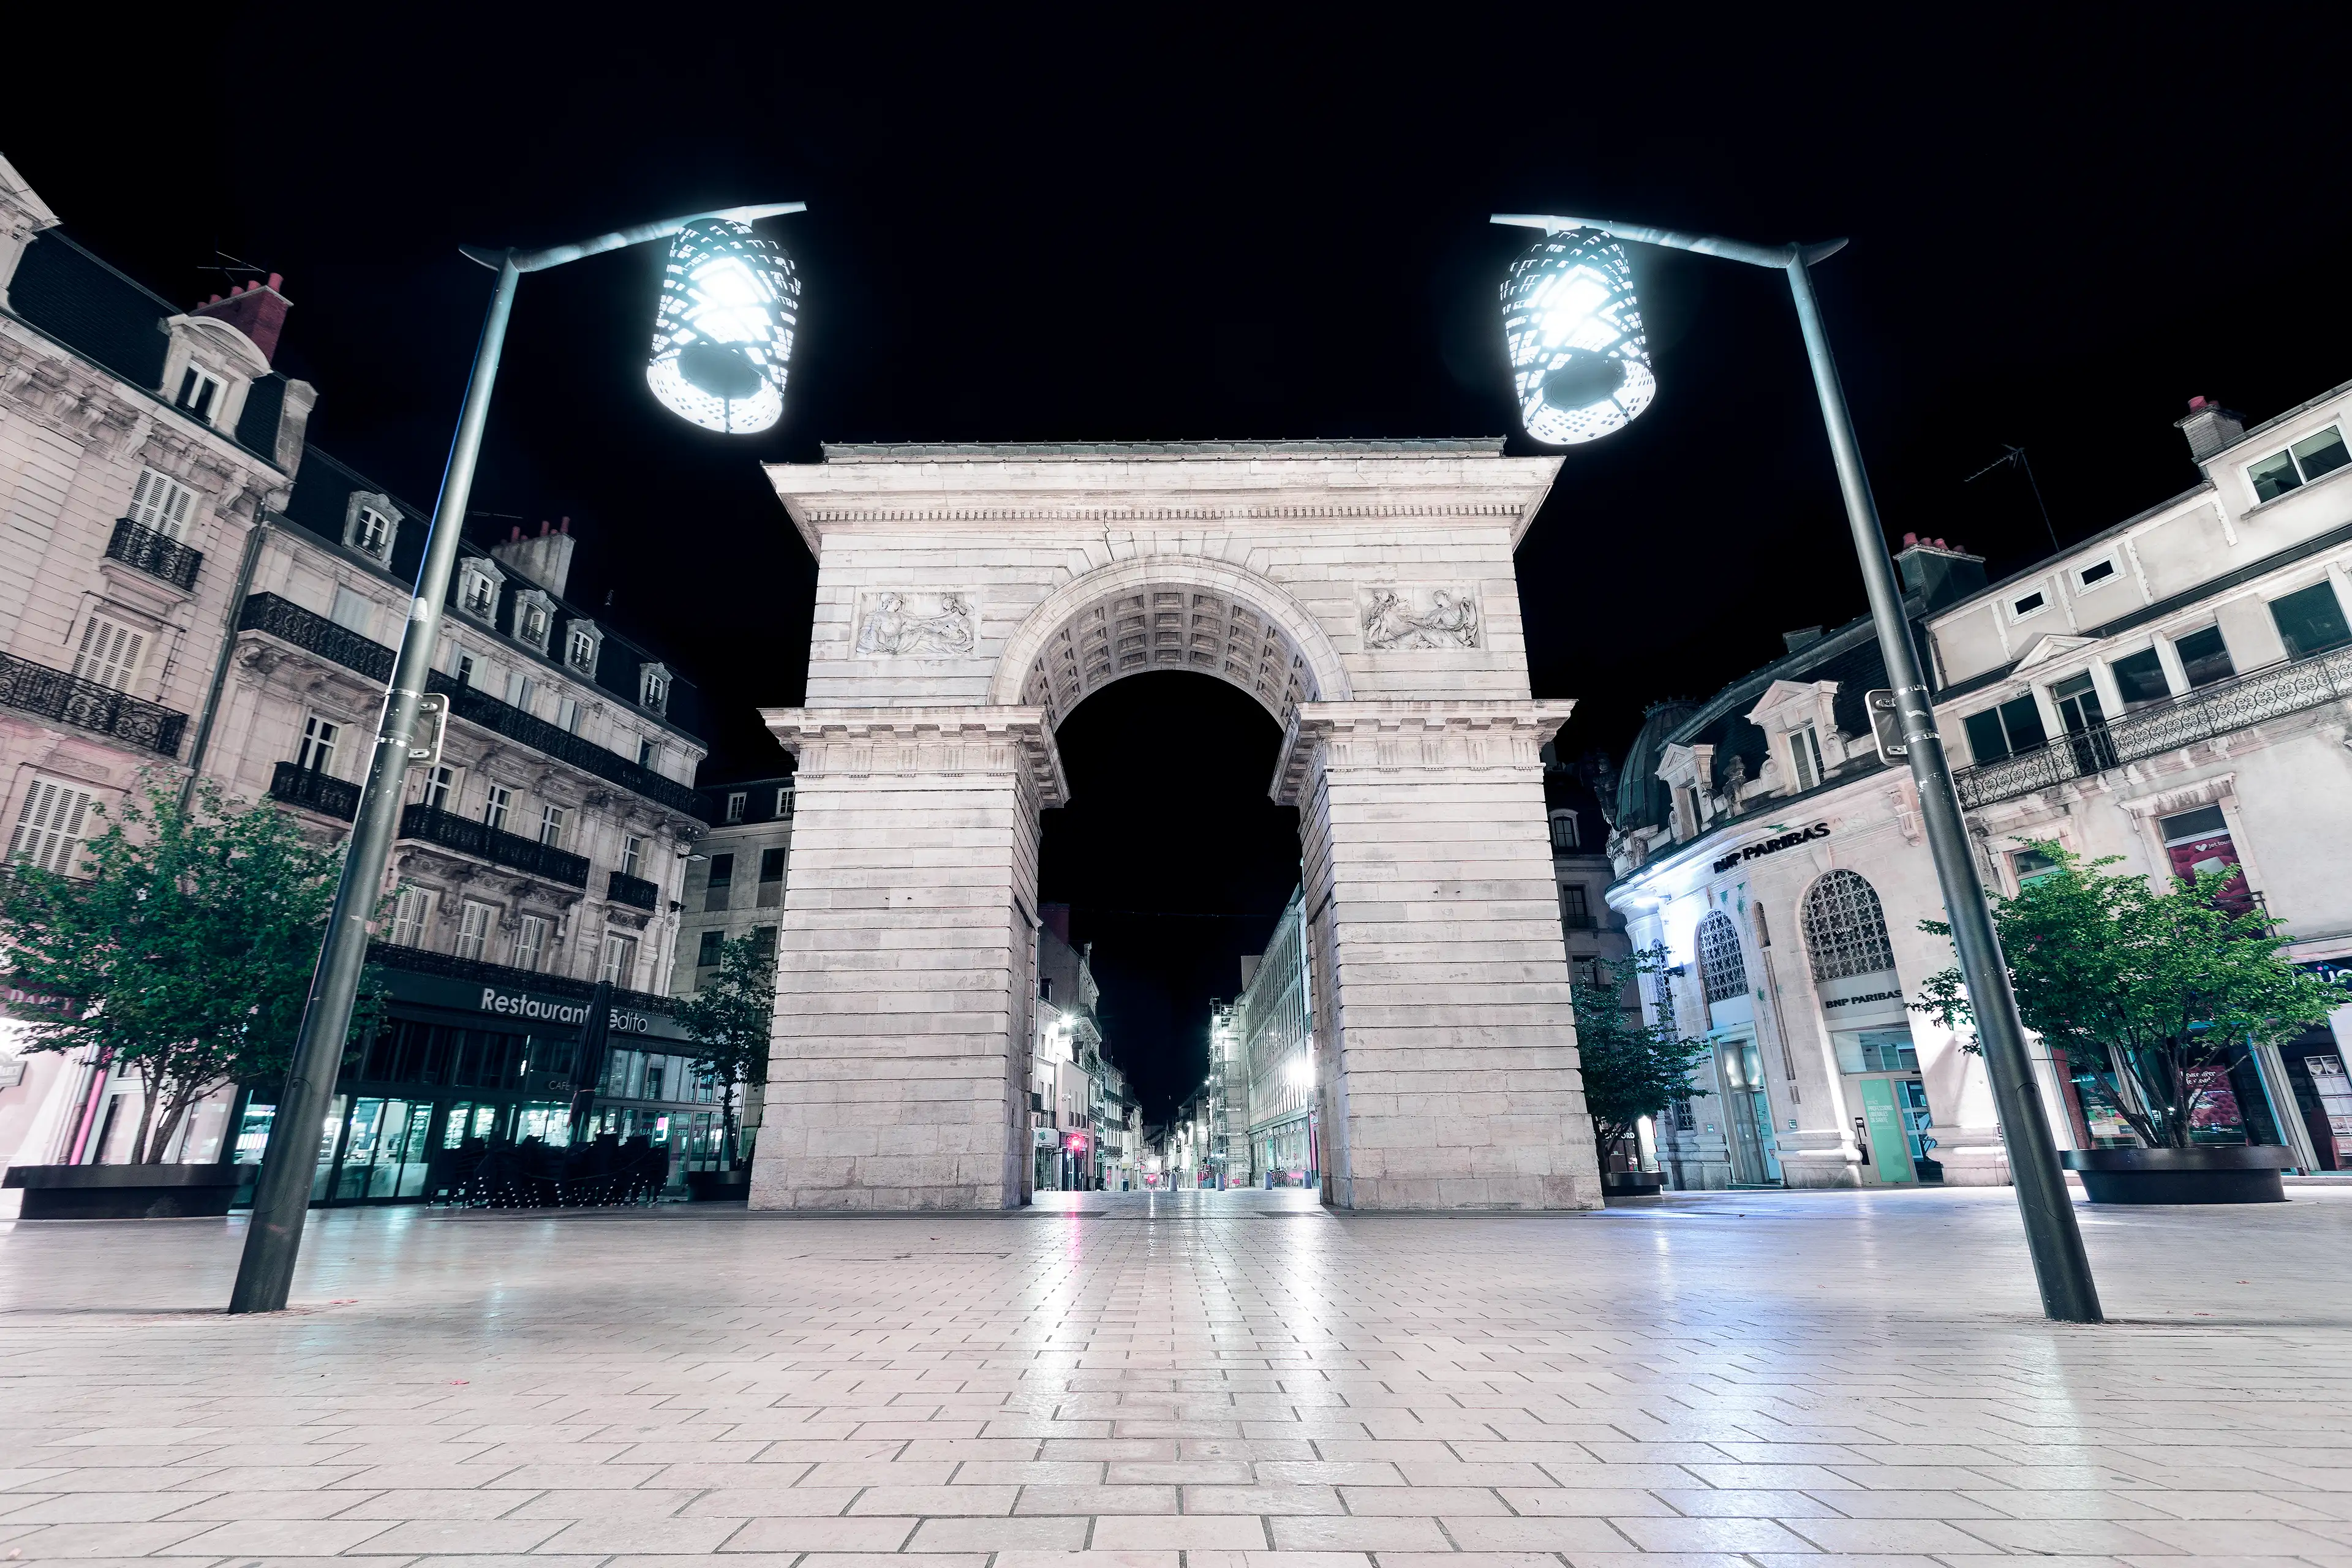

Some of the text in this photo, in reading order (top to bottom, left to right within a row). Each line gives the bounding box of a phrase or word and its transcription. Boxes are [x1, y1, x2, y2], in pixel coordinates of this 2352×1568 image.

[1743, 823, 1831, 861] PARIBAS
[481, 988, 591, 1024] Restaurant
[1825, 989, 1903, 1009] BNP PARIBAS
